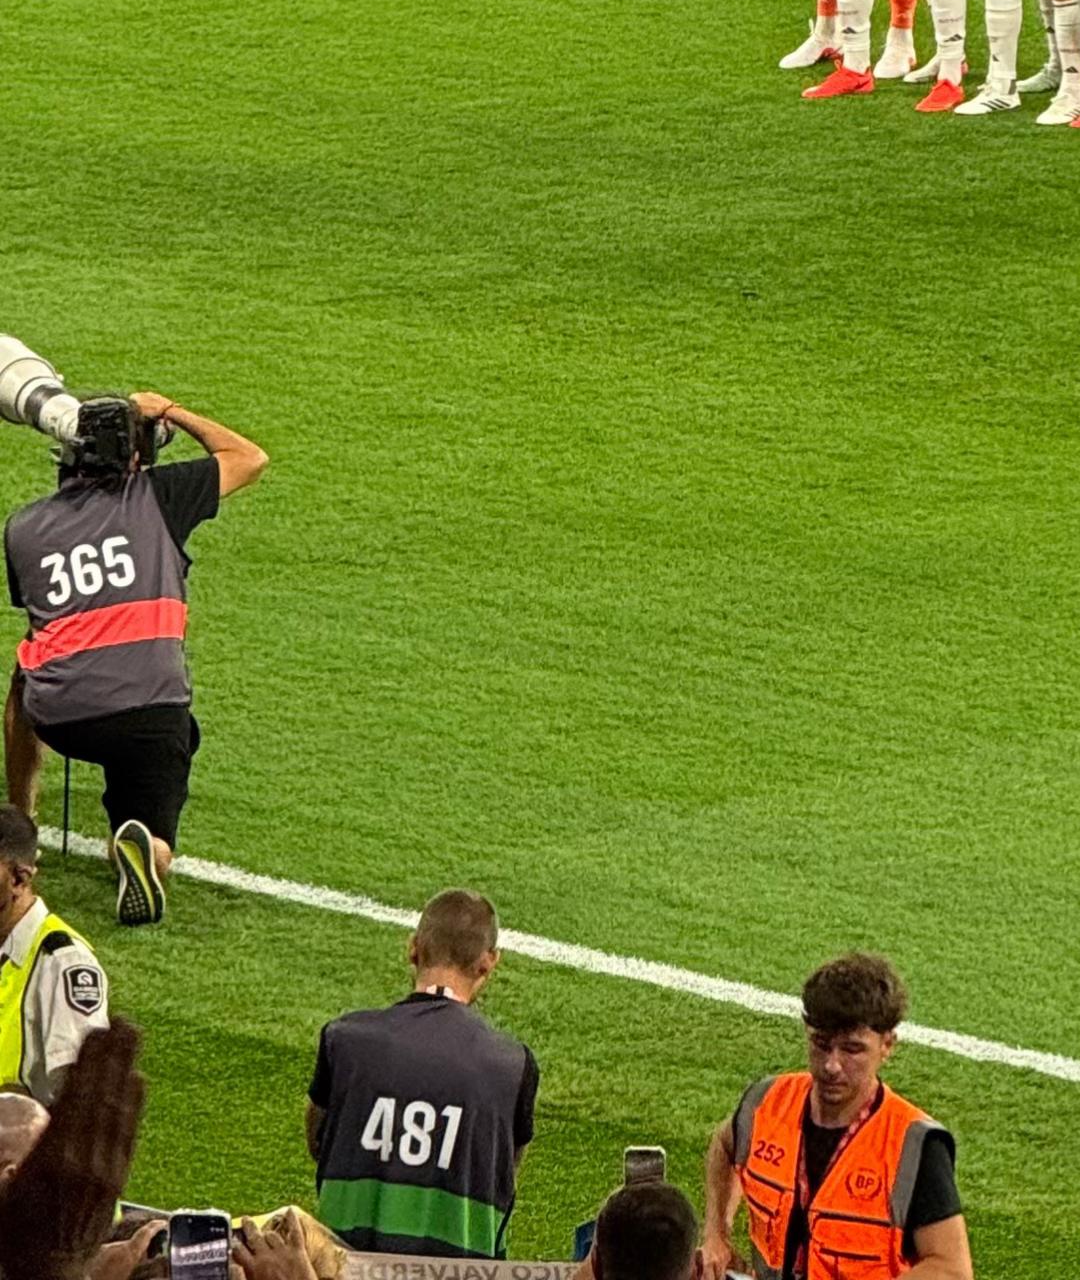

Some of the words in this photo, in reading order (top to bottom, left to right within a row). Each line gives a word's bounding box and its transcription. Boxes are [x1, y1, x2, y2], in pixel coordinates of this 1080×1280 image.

[40, 536, 136, 606] 365
[361, 1097, 463, 1170] 481
[753, 1140, 785, 1167] 252
